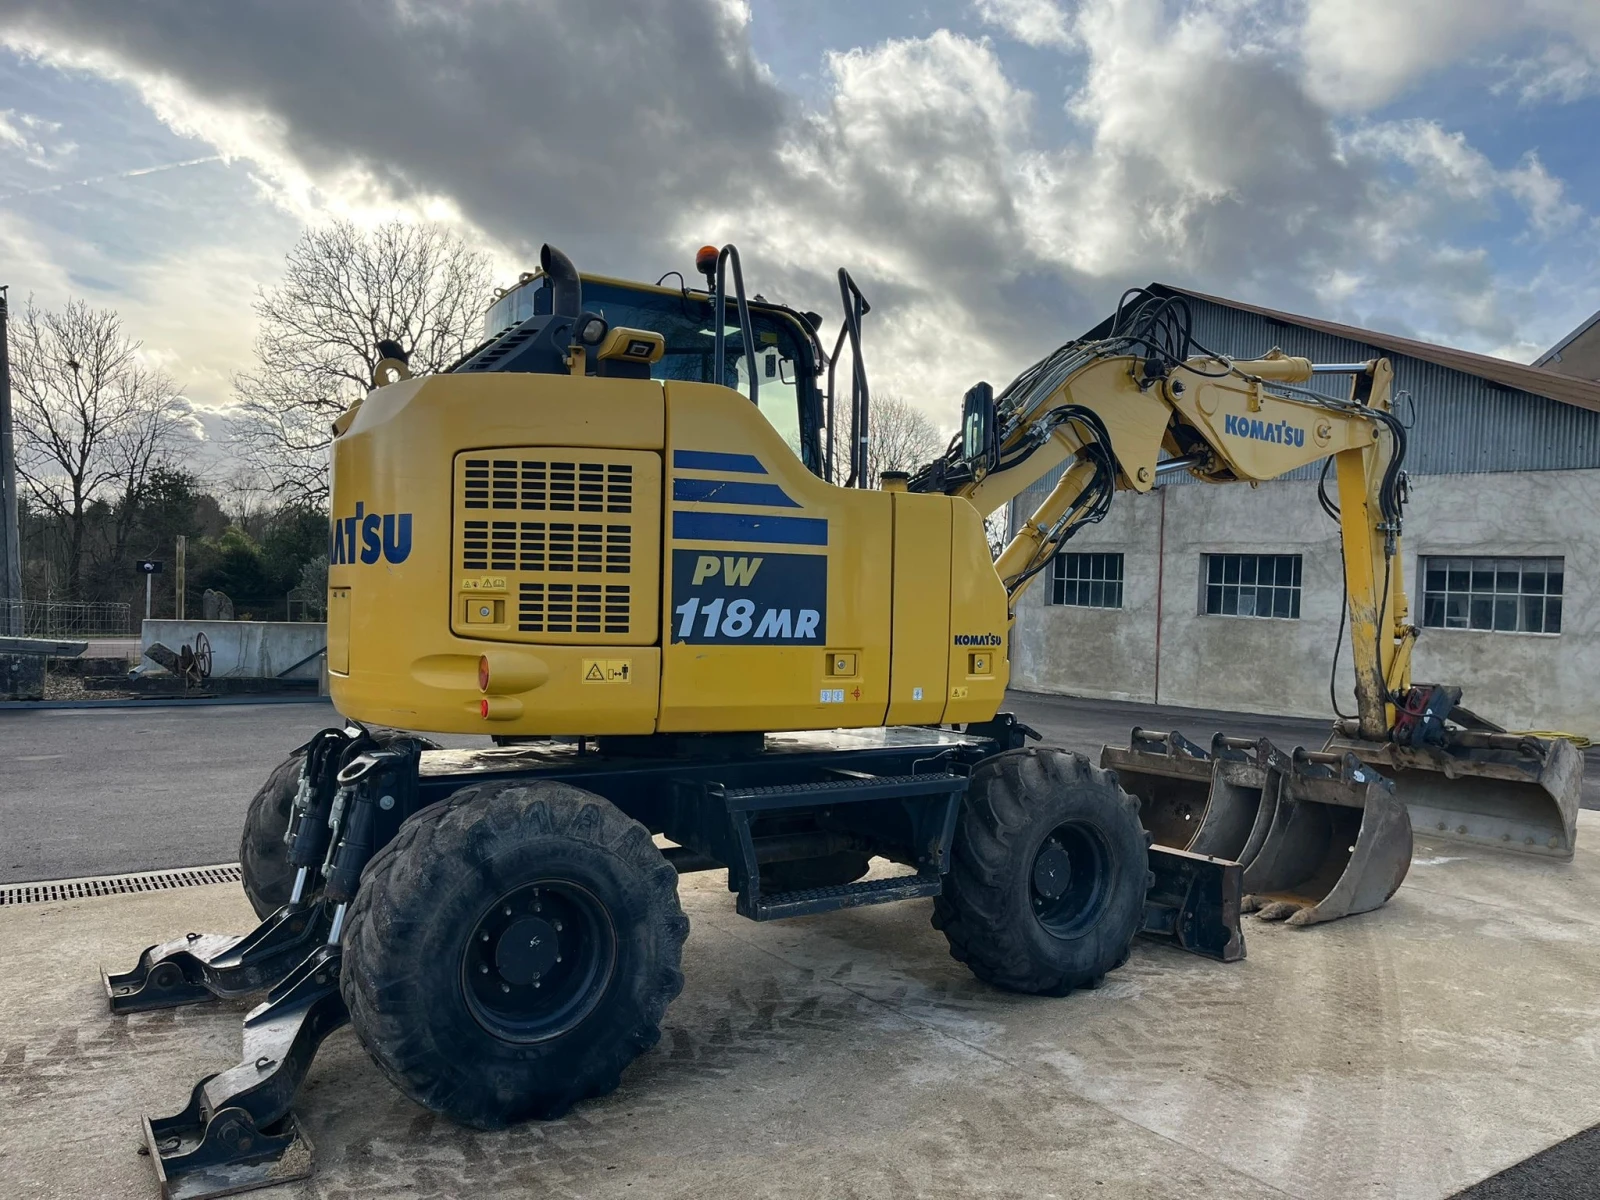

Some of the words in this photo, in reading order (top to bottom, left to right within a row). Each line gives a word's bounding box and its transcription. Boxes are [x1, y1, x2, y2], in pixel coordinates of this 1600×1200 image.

[1225, 413, 1305, 448] KOMATSU
[691, 555, 764, 587] PW
[675, 597, 820, 638] 118MR
[954, 632, 1002, 646] KOMATSU
